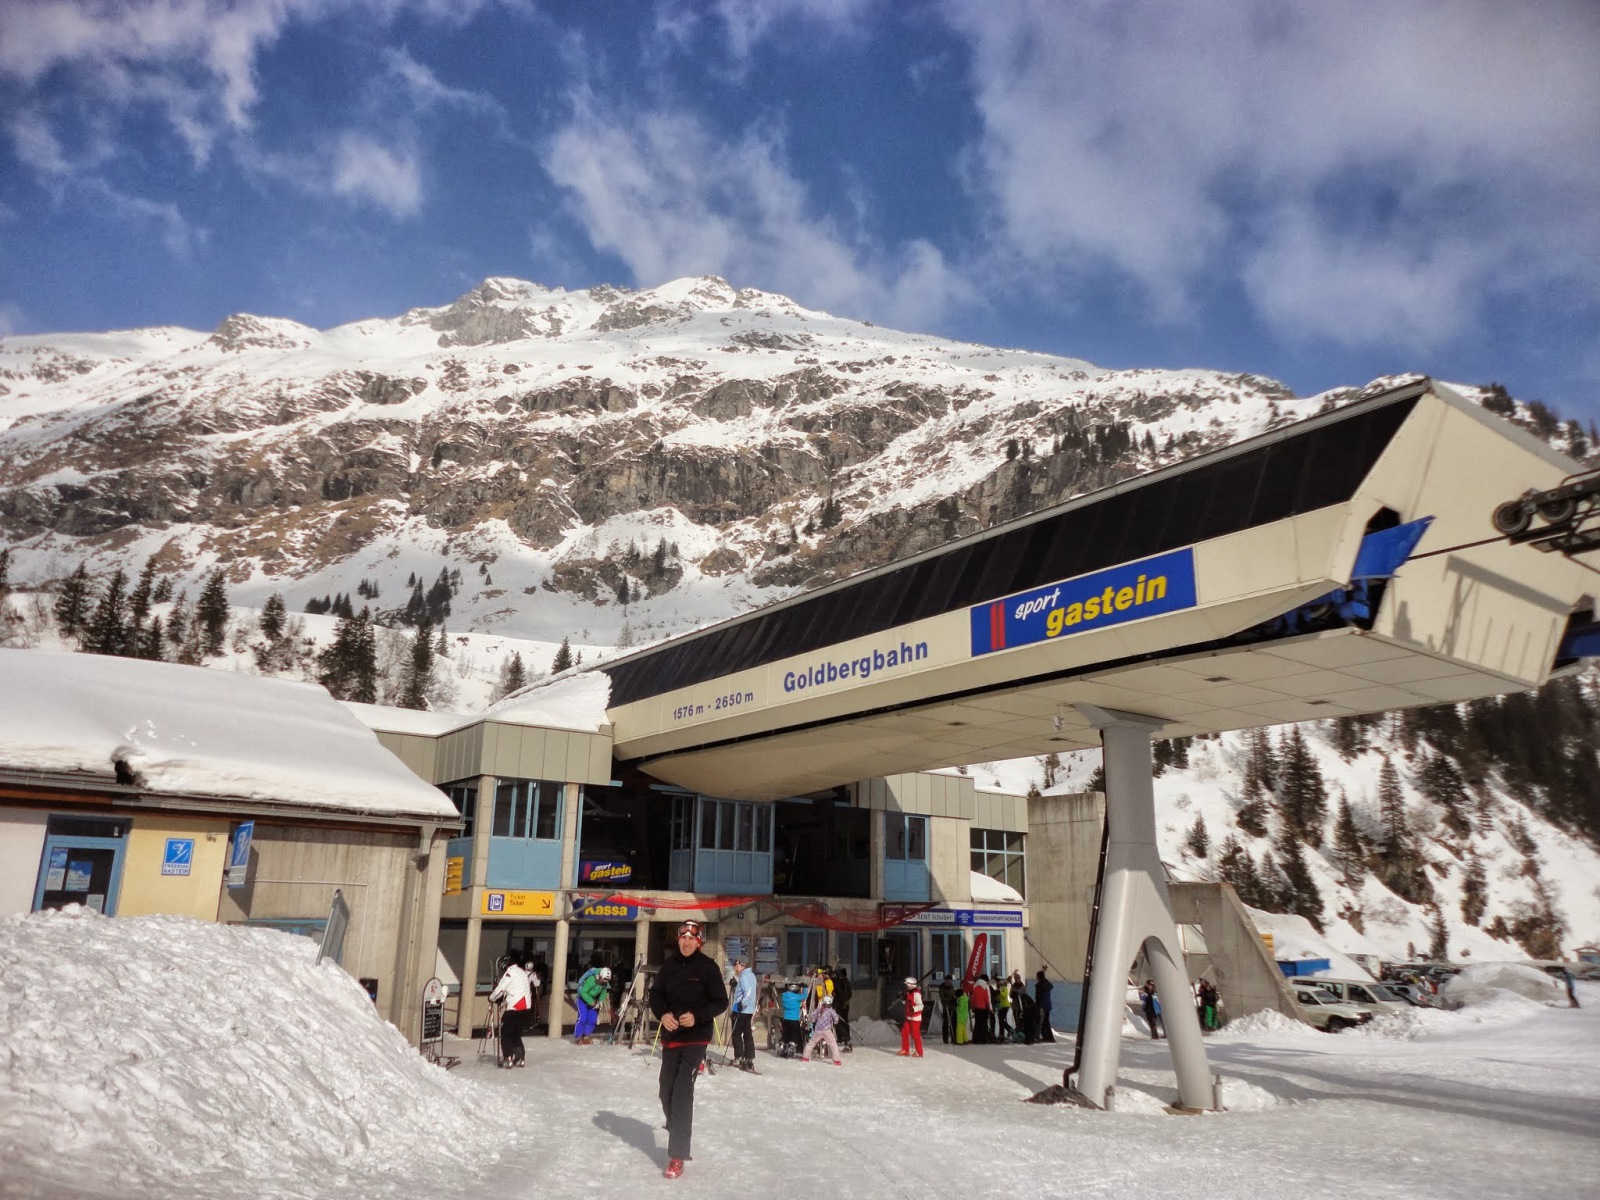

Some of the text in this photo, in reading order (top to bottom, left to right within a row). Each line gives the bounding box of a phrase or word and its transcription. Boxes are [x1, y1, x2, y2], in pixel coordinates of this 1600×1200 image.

[1014, 587, 1061, 621] sport
[1046, 574, 1168, 638] gastein
[783, 641, 928, 693] Goldbergbahn
[673, 704, 694, 720] 1576
[695, 705, 704, 715] m
[715, 692, 742, 710] 2650
[744, 691, 754, 703] m
[590, 864, 632, 881] gastein
[510, 893, 526, 901] Ticket
[584, 904, 628, 917] Kassa
[971, 942, 984, 977] ATOMIC
